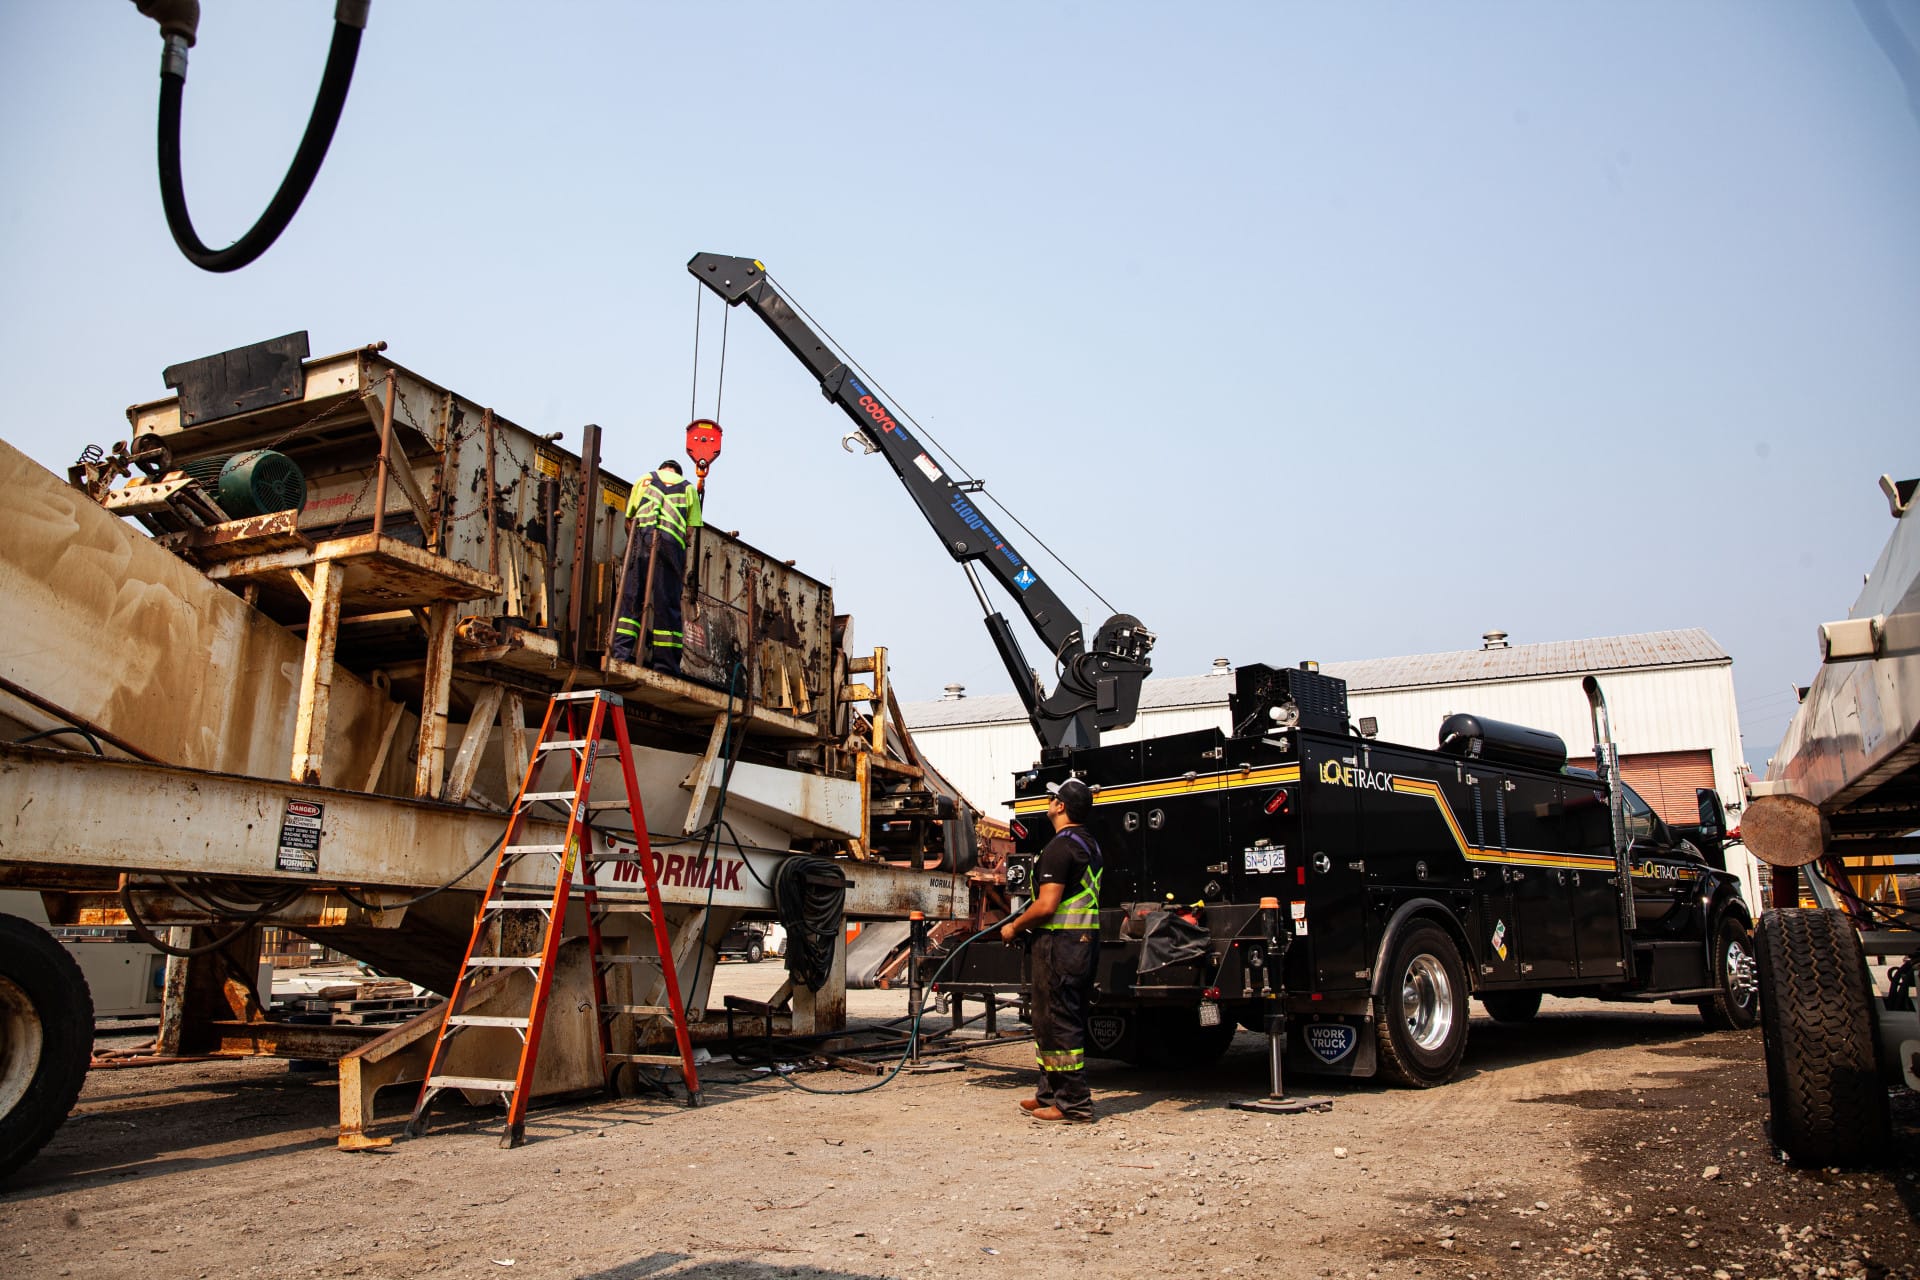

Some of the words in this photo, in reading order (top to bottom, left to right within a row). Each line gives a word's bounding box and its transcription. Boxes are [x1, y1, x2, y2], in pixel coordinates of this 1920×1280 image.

[858, 395, 896, 433] cobra
[605, 481, 626, 497] CAUTION
[1319, 759, 1393, 792] LONETRACK
[290, 805, 317, 813] DANGER
[1642, 860, 1679, 880] LONETRACK
[929, 878, 957, 890] MORMA
[1312, 1028, 1346, 1039] WORK
[1312, 1038, 1347, 1049] TRUCK
